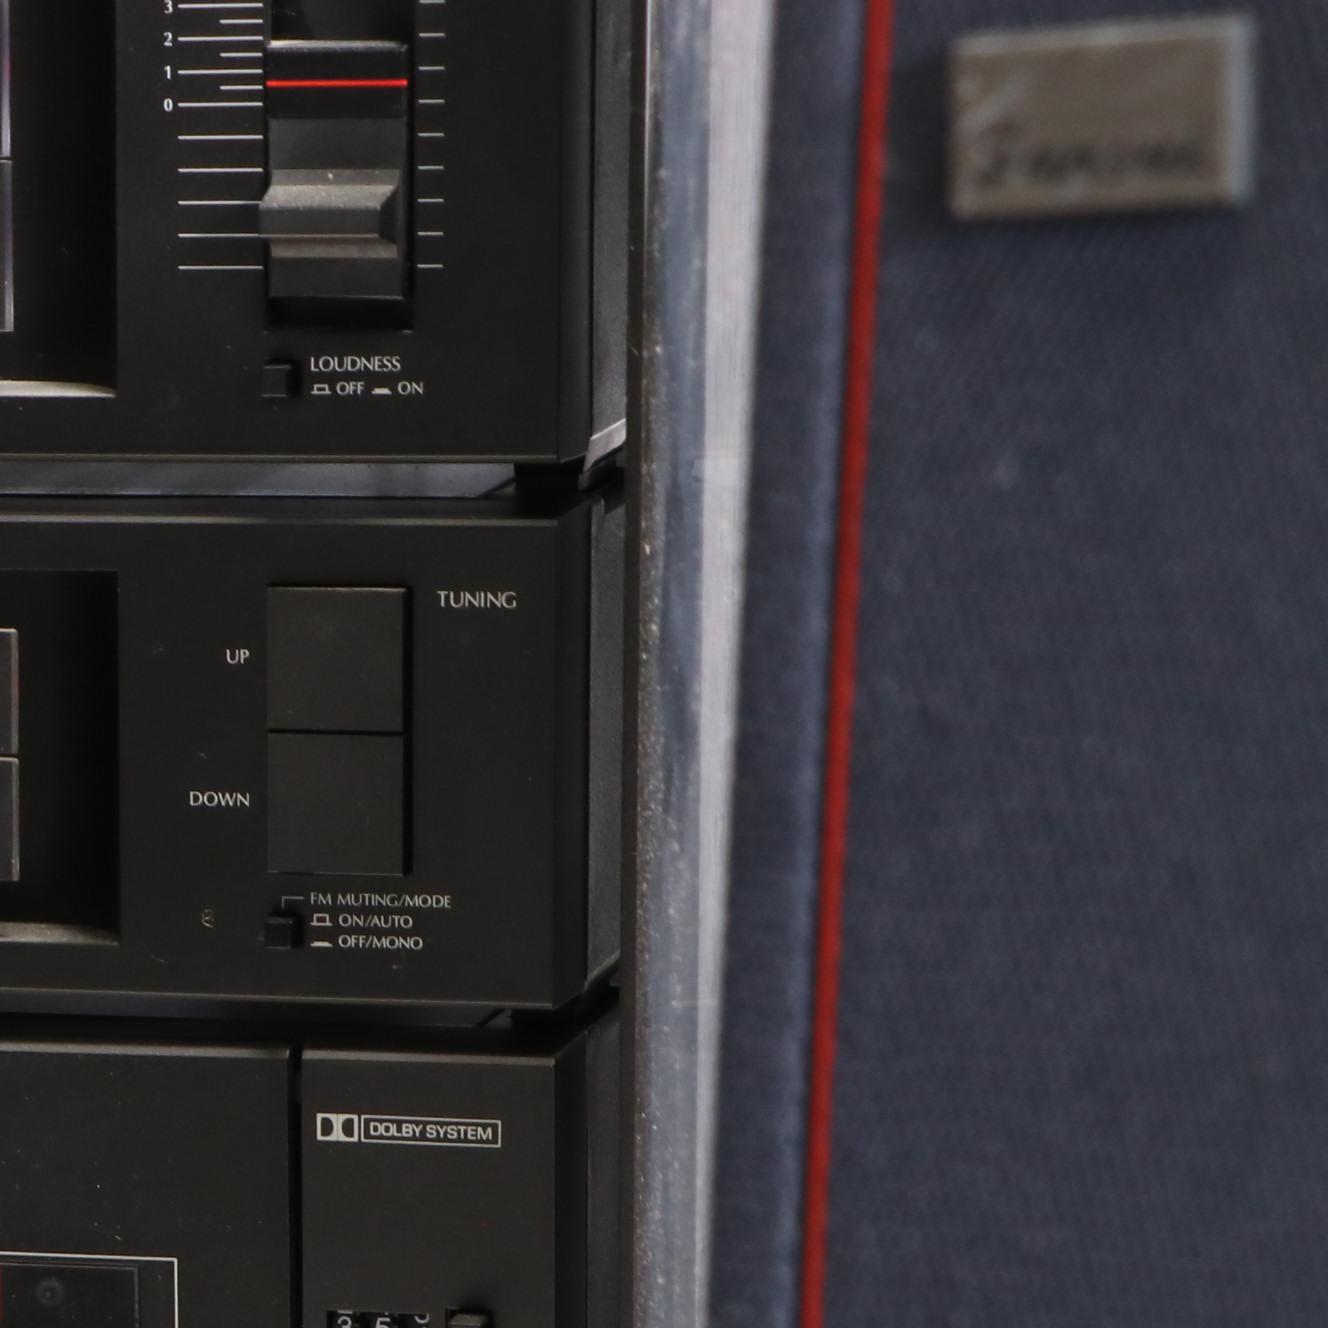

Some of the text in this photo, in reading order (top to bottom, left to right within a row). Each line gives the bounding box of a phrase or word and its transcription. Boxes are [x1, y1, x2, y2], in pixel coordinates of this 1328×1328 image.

[310, 355, 401, 372] LOUDNESS
[436, 591, 517, 609] TUNING
[226, 649, 250, 665] UP
[189, 791, 250, 807] DOWN
[310, 892, 451, 909] FM MUTING/MODE
[338, 914, 413, 929] ON/AUTO
[338, 935, 423, 950] OFF/MONO
[369, 1121, 493, 1140] DOLBY SYSTEM
